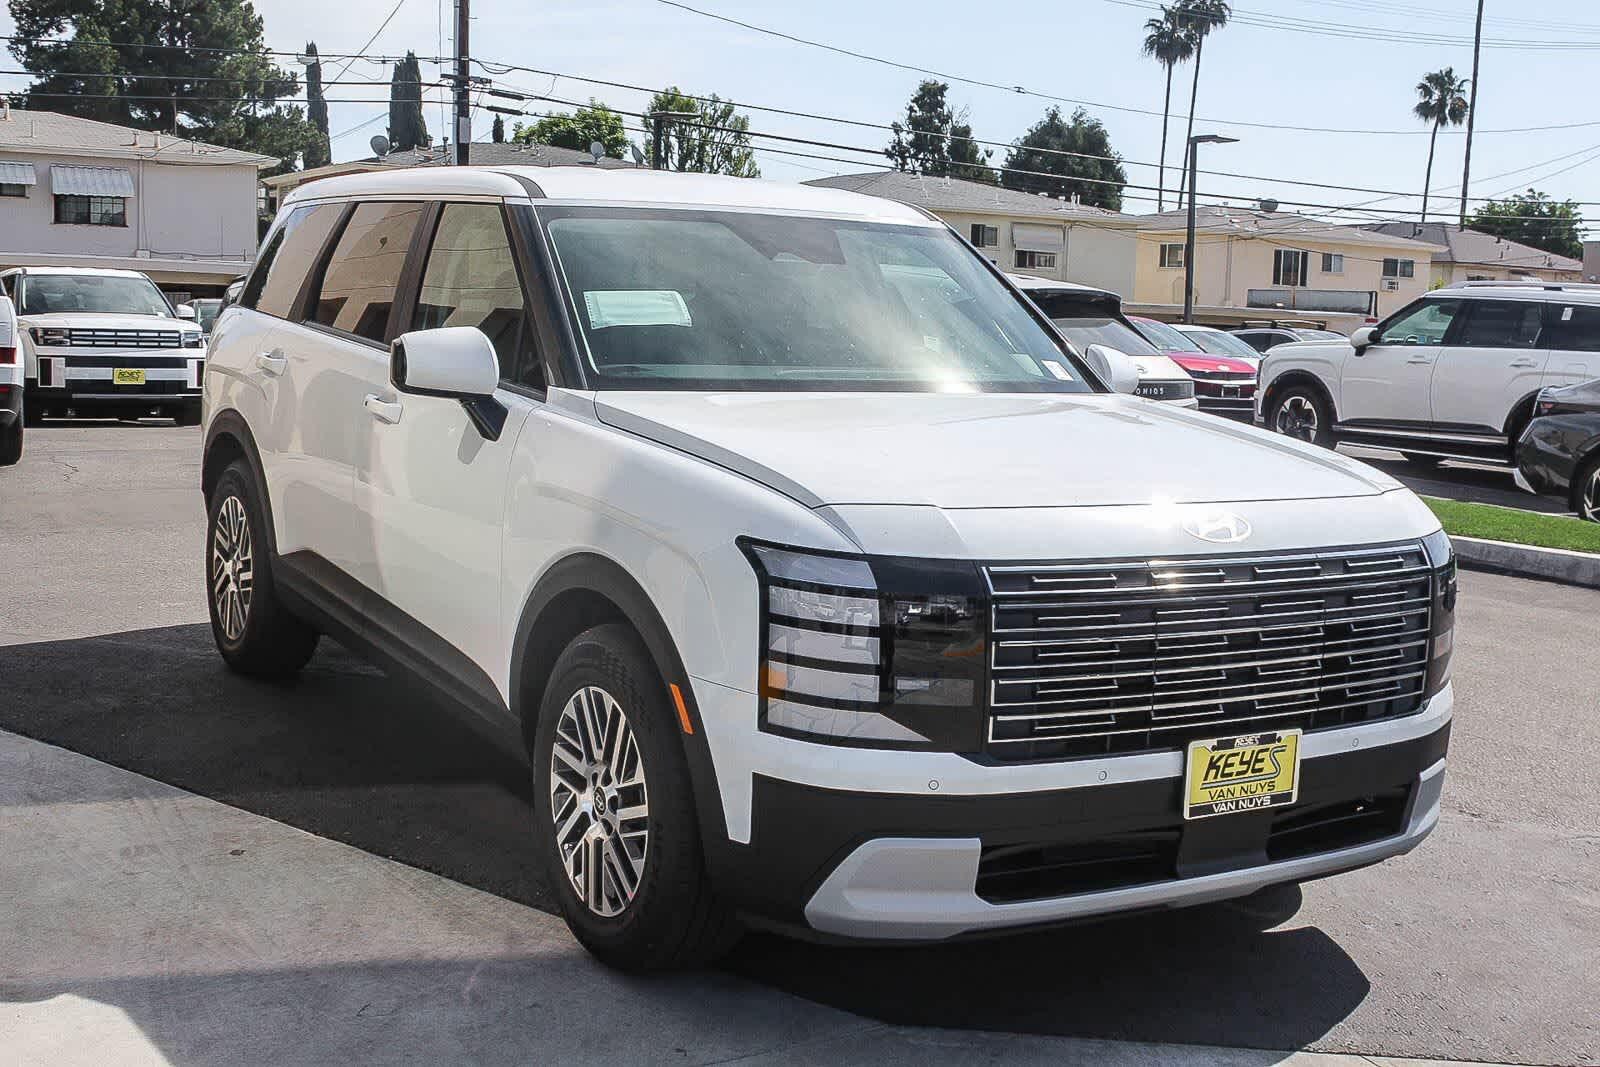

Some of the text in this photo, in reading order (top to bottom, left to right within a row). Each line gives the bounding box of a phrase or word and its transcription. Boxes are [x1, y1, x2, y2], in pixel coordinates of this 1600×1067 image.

[1234, 735, 1260, 748] KEYES
[1201, 745, 1287, 785] KEYES
[1208, 780, 1276, 801] VAN NUYS
[1212, 795, 1272, 813] VAN NUYS
